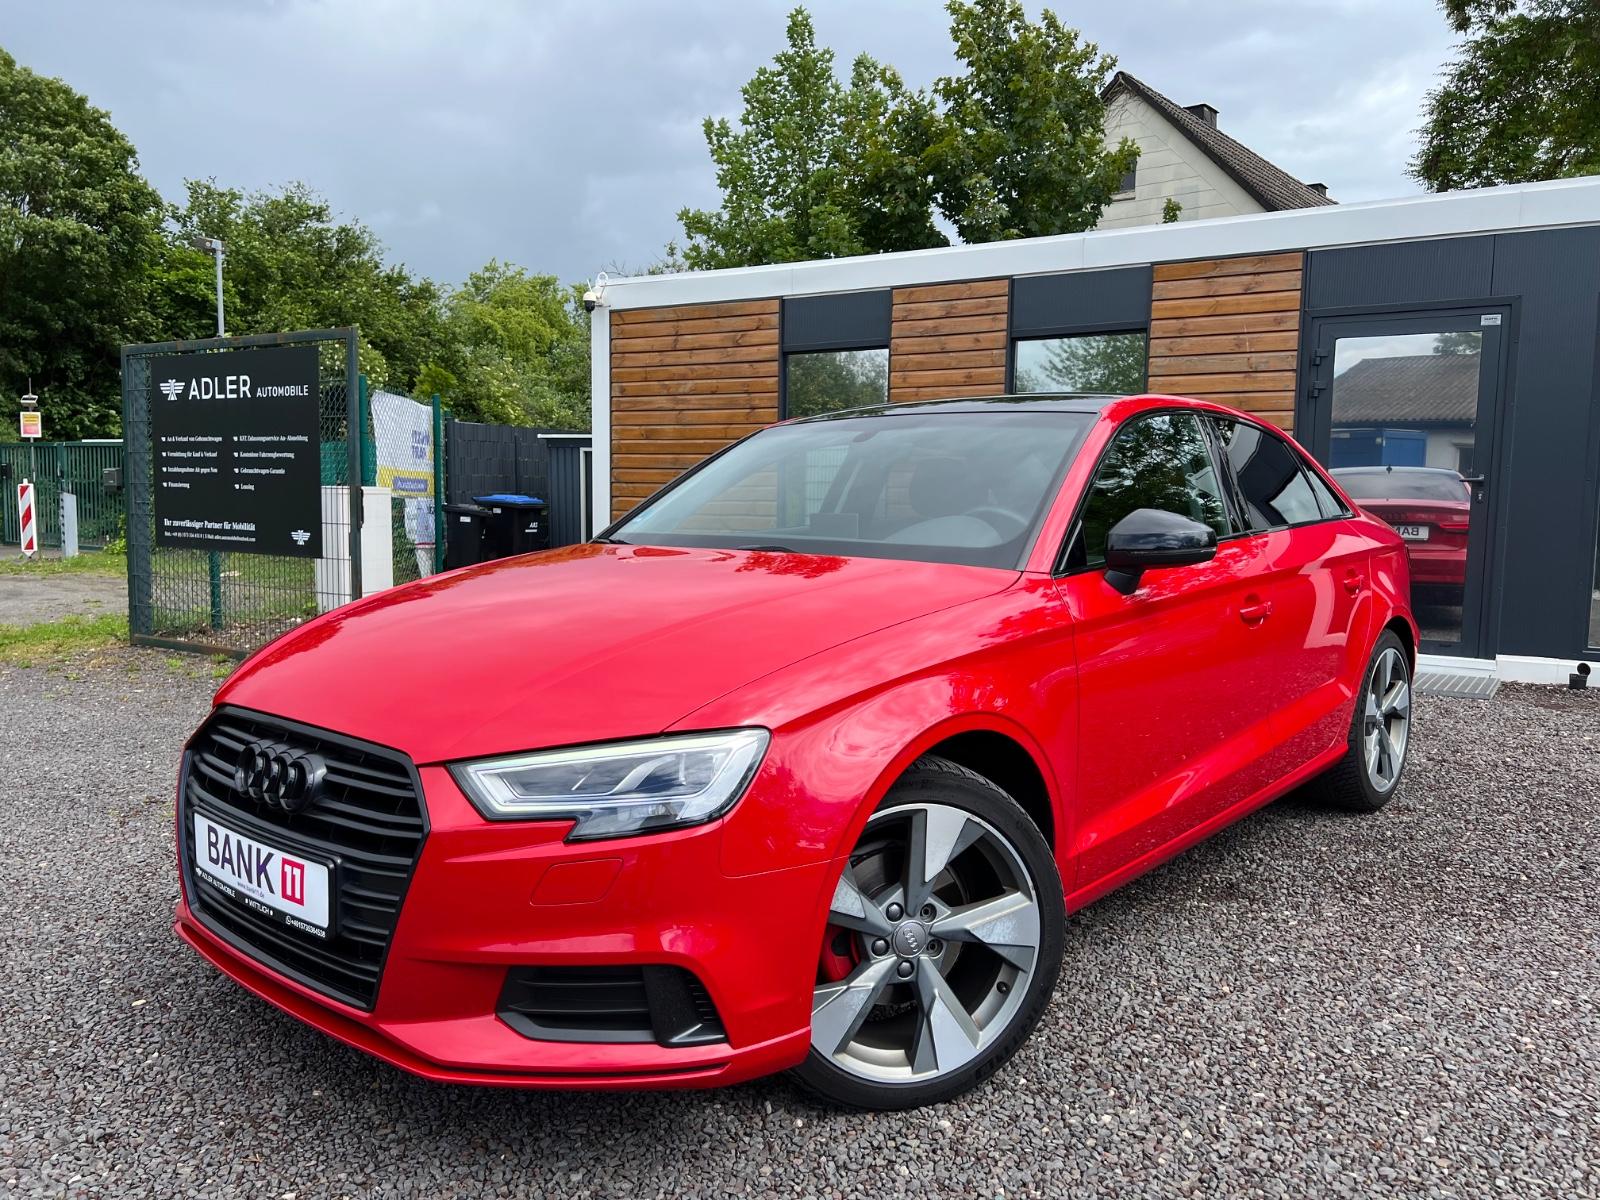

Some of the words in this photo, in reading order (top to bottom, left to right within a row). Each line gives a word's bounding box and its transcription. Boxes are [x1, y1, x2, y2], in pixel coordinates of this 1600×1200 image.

[189, 375, 251, 400] ADLER
[256, 385, 309, 398] AUTOMOBILE
[164, 518, 172, 526] Ihr
[172, 519, 204, 530] zuverlässiger
[204, 520, 223, 530] Partner
[223, 521, 232, 530] für
[232, 522, 256, 532] Mobilität
[207, 823, 275, 895] BANK
[283, 861, 303, 903] 11
